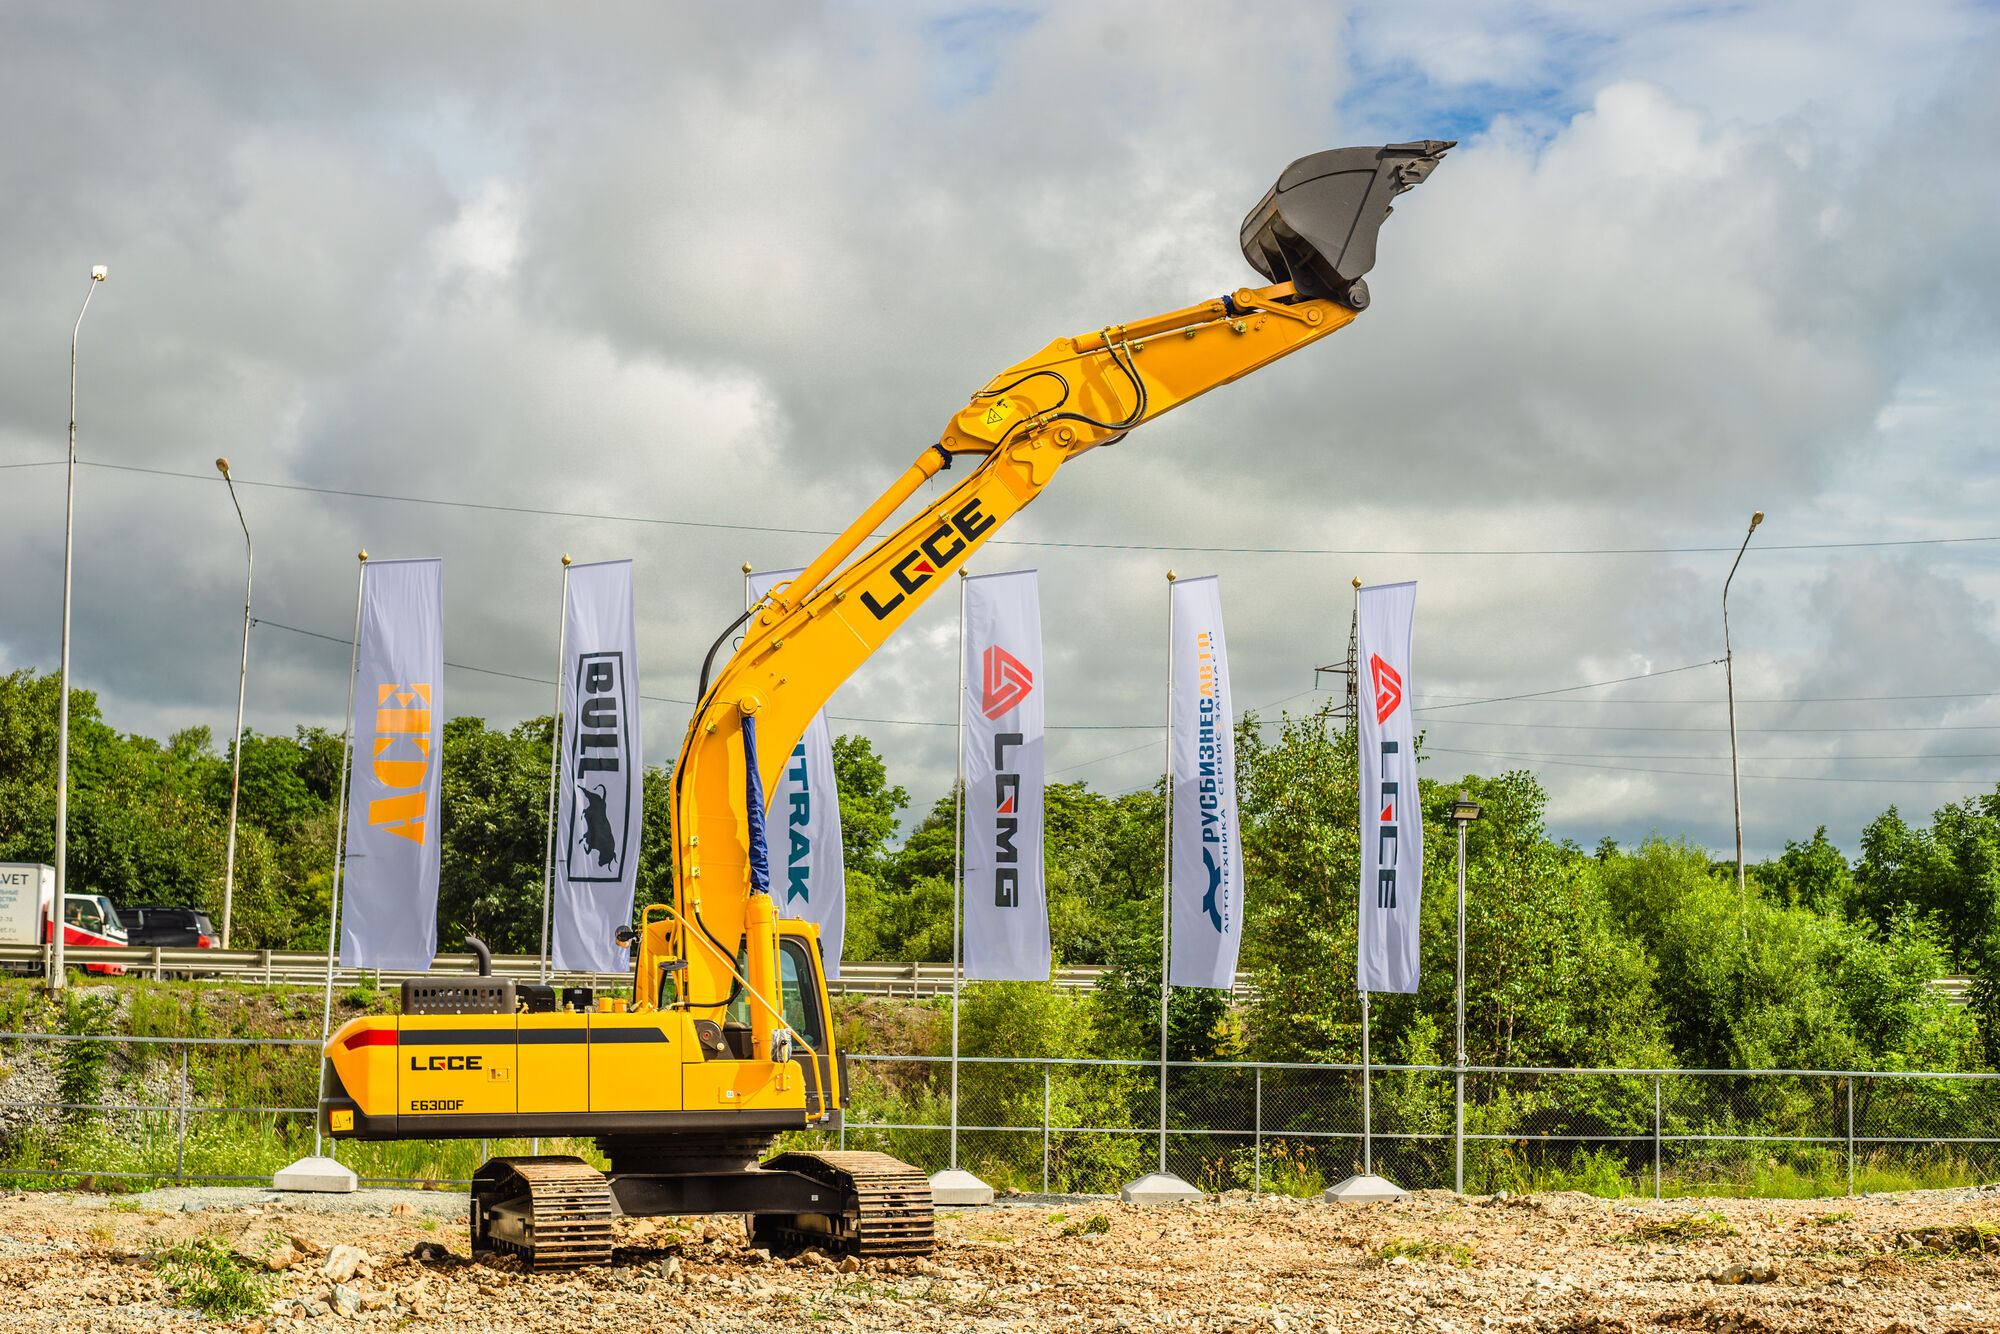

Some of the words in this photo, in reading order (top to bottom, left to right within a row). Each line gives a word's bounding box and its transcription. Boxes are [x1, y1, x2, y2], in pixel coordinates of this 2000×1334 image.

[368, 683, 431, 846] ACE
[577, 662, 619, 779] BULL
[1197, 632, 1221, 843] РУСБИЗНЕСАВТО
[1215, 732, 1225, 796] СЕРВИС
[788, 734, 811, 905] ITRAK
[994, 733, 1024, 908] LGMG
[411, 1100, 464, 1110] E6300F
